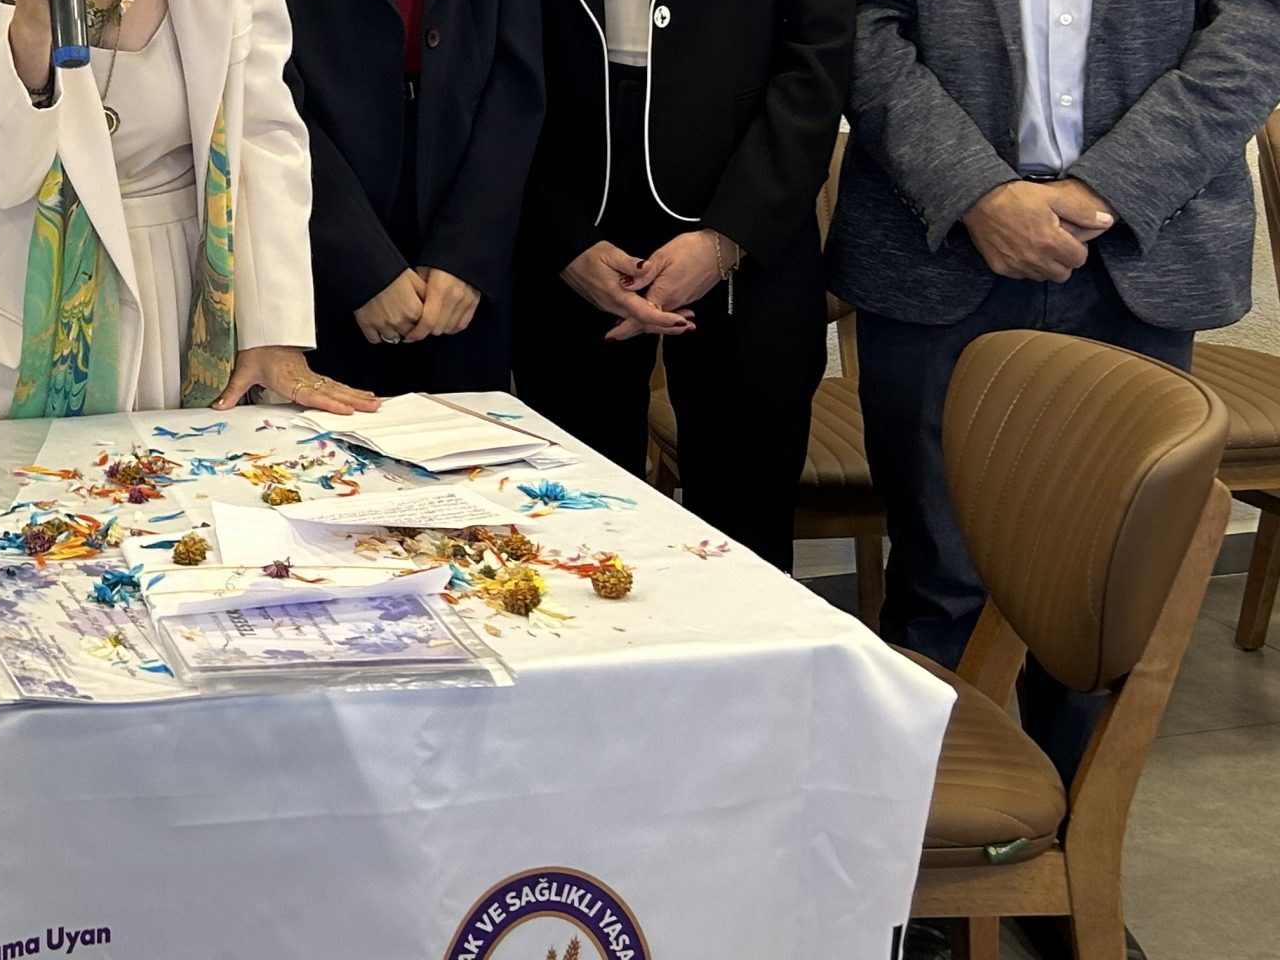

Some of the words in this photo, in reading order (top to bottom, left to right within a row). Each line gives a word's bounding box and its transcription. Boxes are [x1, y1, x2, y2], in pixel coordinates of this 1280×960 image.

[475, 902, 507, 933] VE
[505, 877, 603, 918] SAĞLIKLI
[46, 926, 111, 955] Uyan
